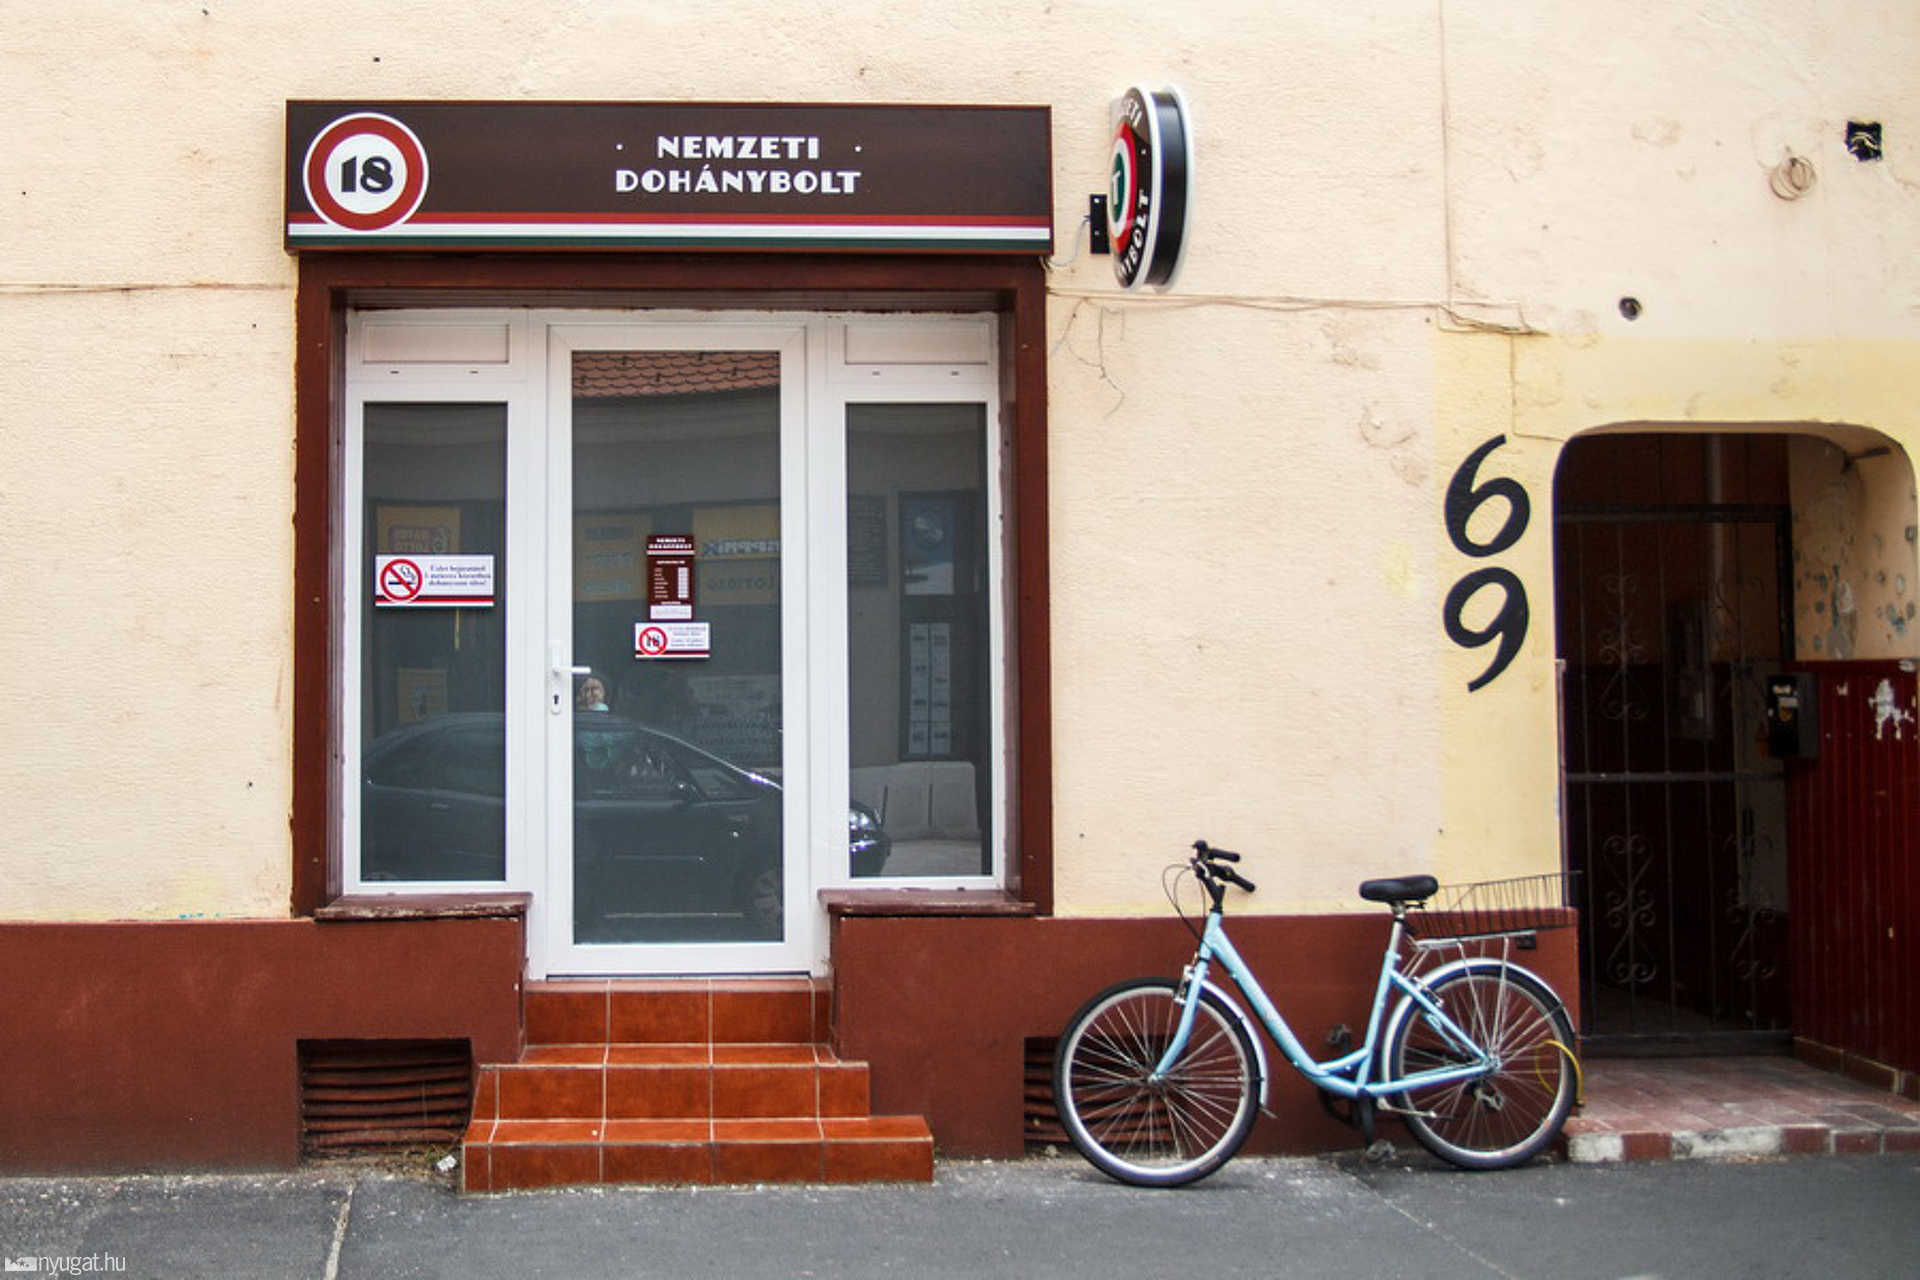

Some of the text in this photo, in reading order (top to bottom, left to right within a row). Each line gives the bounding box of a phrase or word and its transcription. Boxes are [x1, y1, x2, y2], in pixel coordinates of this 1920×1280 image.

[656, 136, 820, 159] NEMZETI
[341, 155, 393, 194] 18
[615, 164, 862, 194] DOHÁNYBOLT
[1443, 433, 1531, 693] 69
